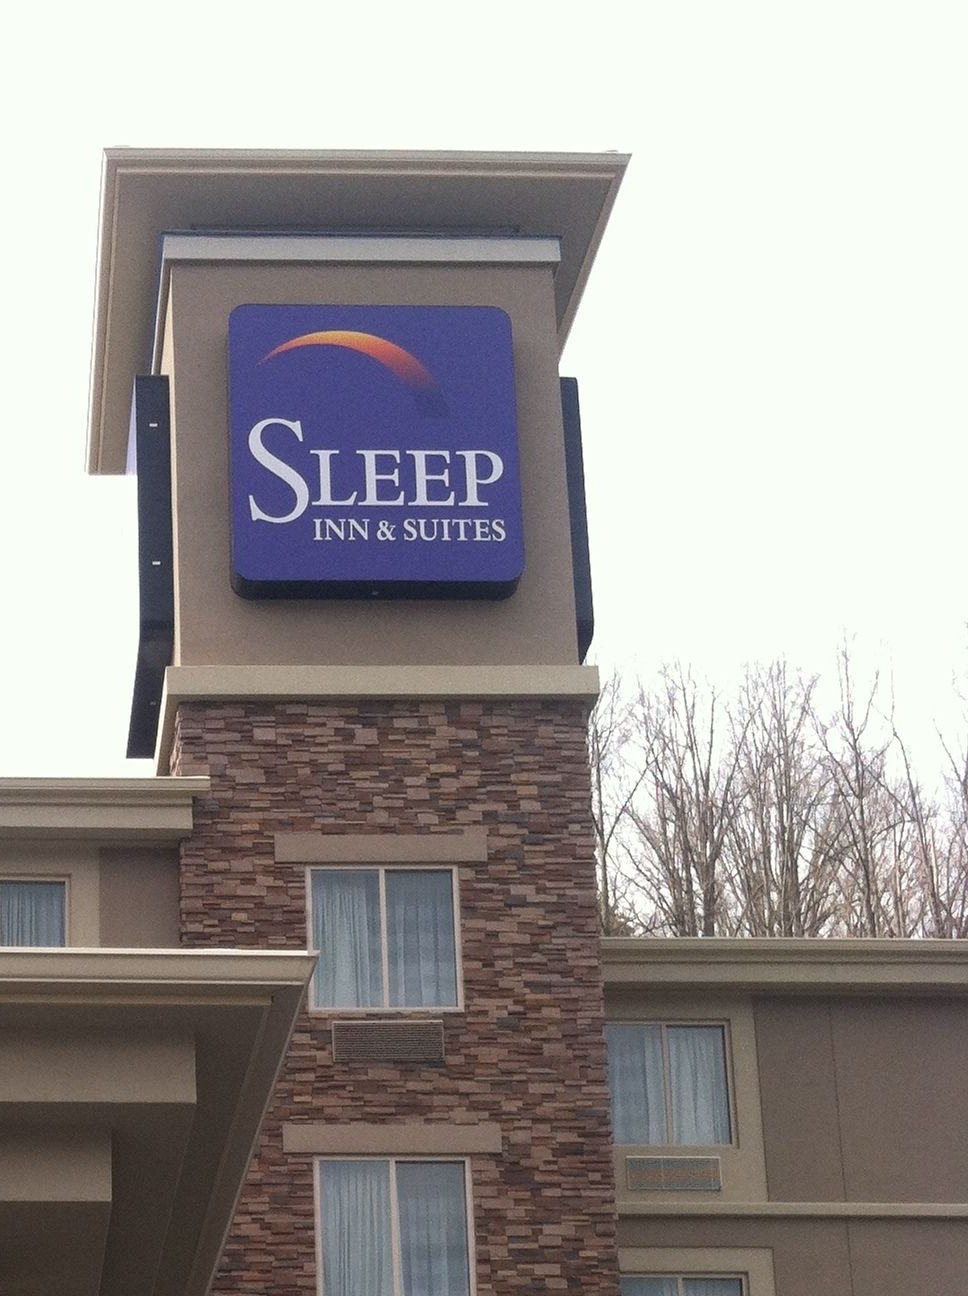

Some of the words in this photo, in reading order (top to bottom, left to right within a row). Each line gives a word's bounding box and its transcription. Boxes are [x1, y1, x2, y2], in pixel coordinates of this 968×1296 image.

[248, 418, 504, 523] SLEEP
[313, 519, 370, 541] INN
[376, 520, 396, 541] &
[403, 519, 506, 542] SUITES
